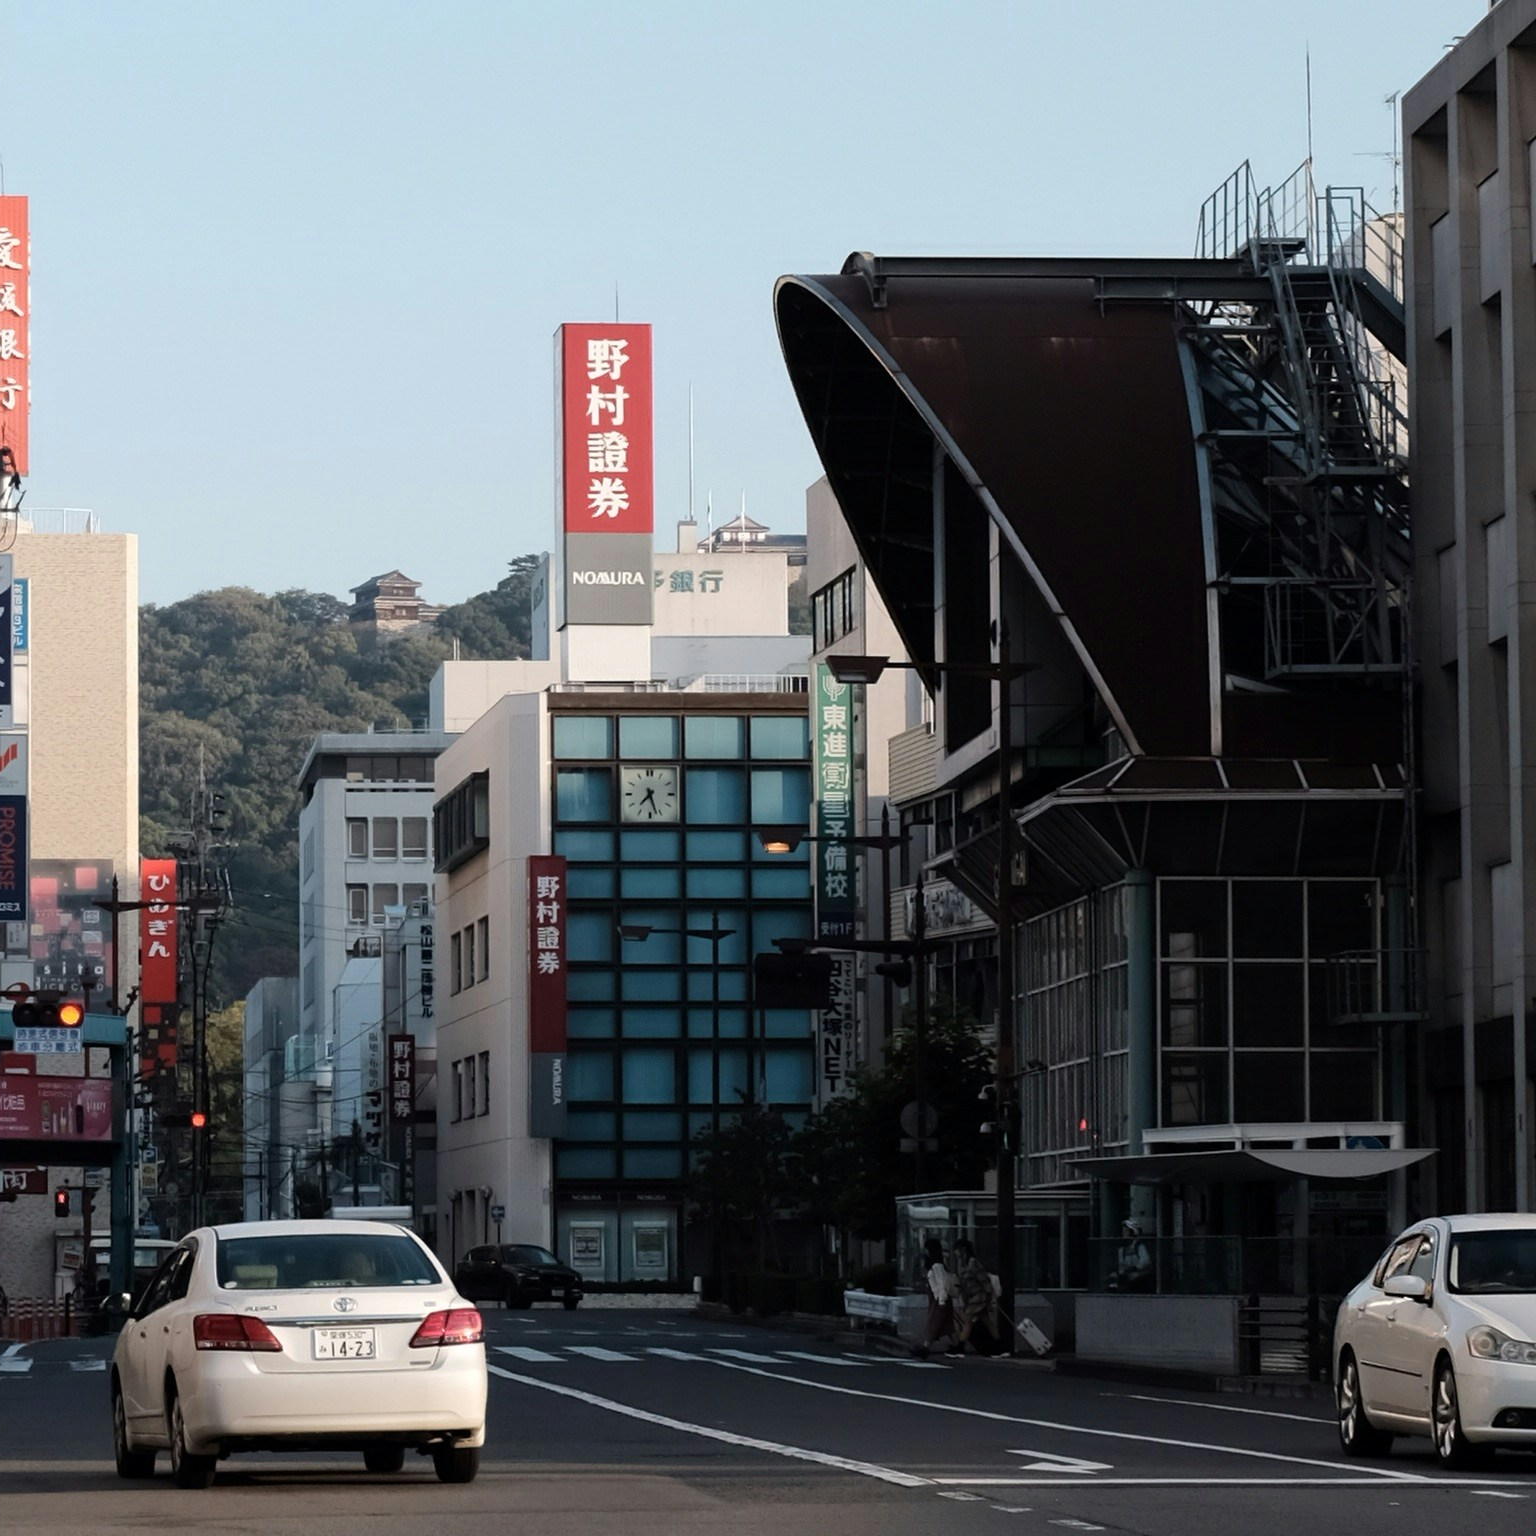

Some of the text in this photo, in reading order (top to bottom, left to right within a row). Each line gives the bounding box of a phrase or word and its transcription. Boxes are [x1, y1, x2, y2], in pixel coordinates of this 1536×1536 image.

[585, 337, 631, 519] 野村證券
[572, 569, 646, 586] NOMURA
[822, 704, 851, 899] 東進衛星予備校
[147, 873, 171, 959] ひめぎん
[536, 876, 560, 975] 野村證券
[392, 1040, 411, 1118] 野村證券
[143, 1150, 155, 1162] P
[331, 1340, 374, 1357] 14-23
